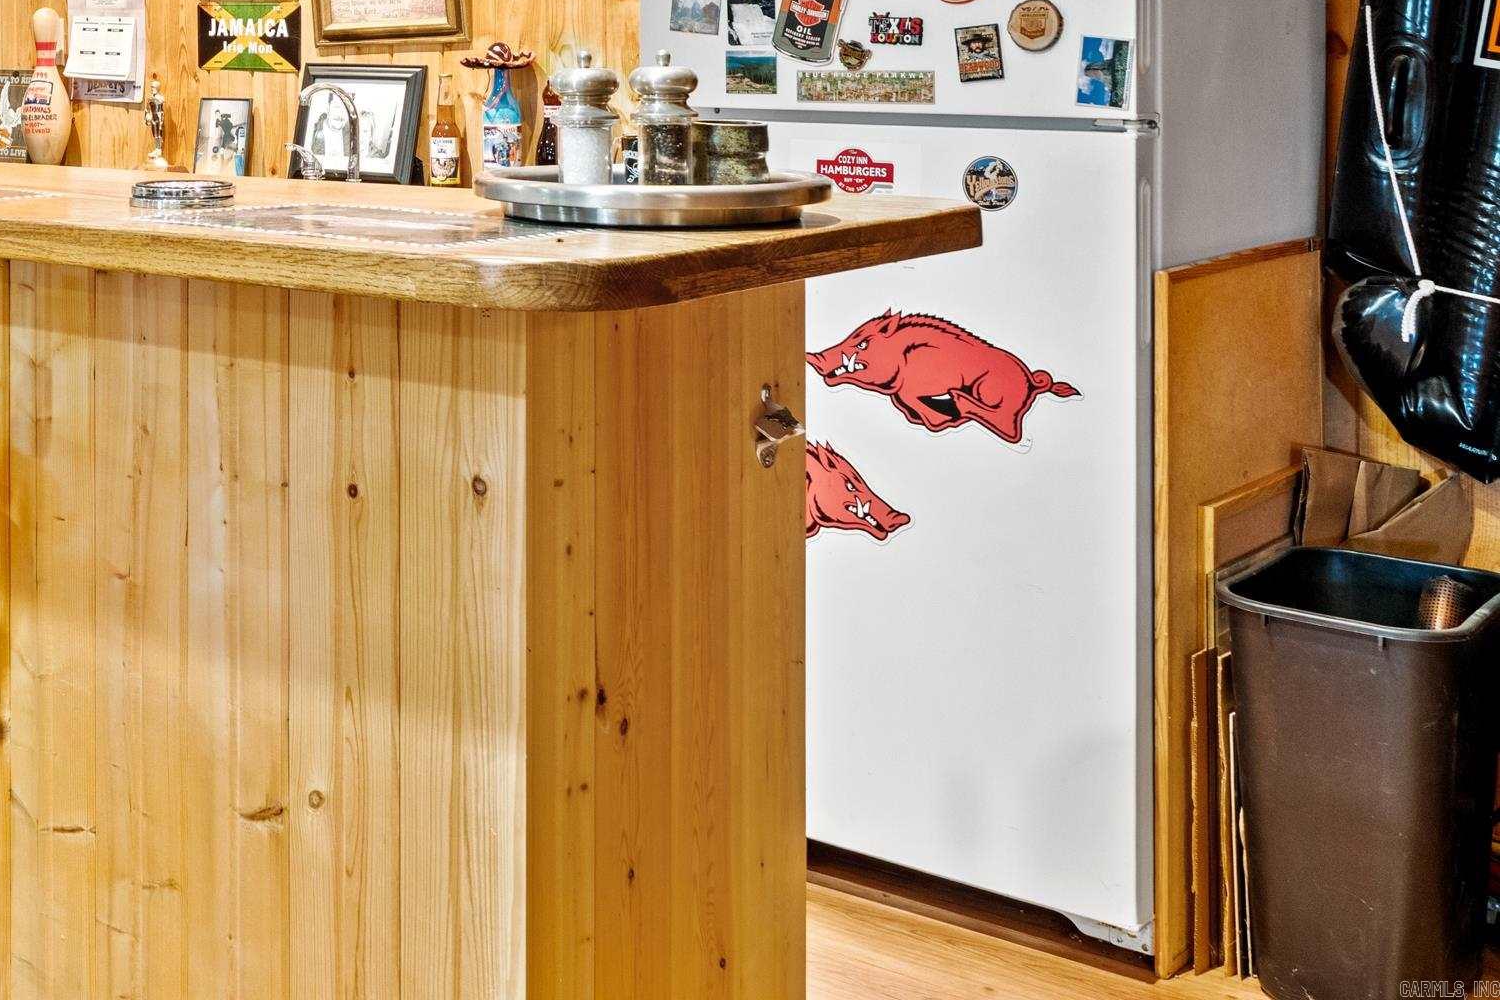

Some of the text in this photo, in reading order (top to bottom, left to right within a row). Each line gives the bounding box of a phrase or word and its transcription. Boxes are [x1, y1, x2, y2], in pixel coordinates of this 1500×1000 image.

[208, 18, 289, 38] JAMAICA
[796, 25, 812, 36] OIL
[869, 17, 923, 35] TEXAS
[870, 33, 922, 44] HOUSTON
[21, 75, 32, 84] RID
[797, 71, 932, 79] BLUE RIDGE PARKWAY
[0, 148, 9, 156] TO
[10, 149, 27, 157] LIVE
[838, 156, 868, 165] COZY INN
[820, 164, 887, 178] HAMBURGERS
